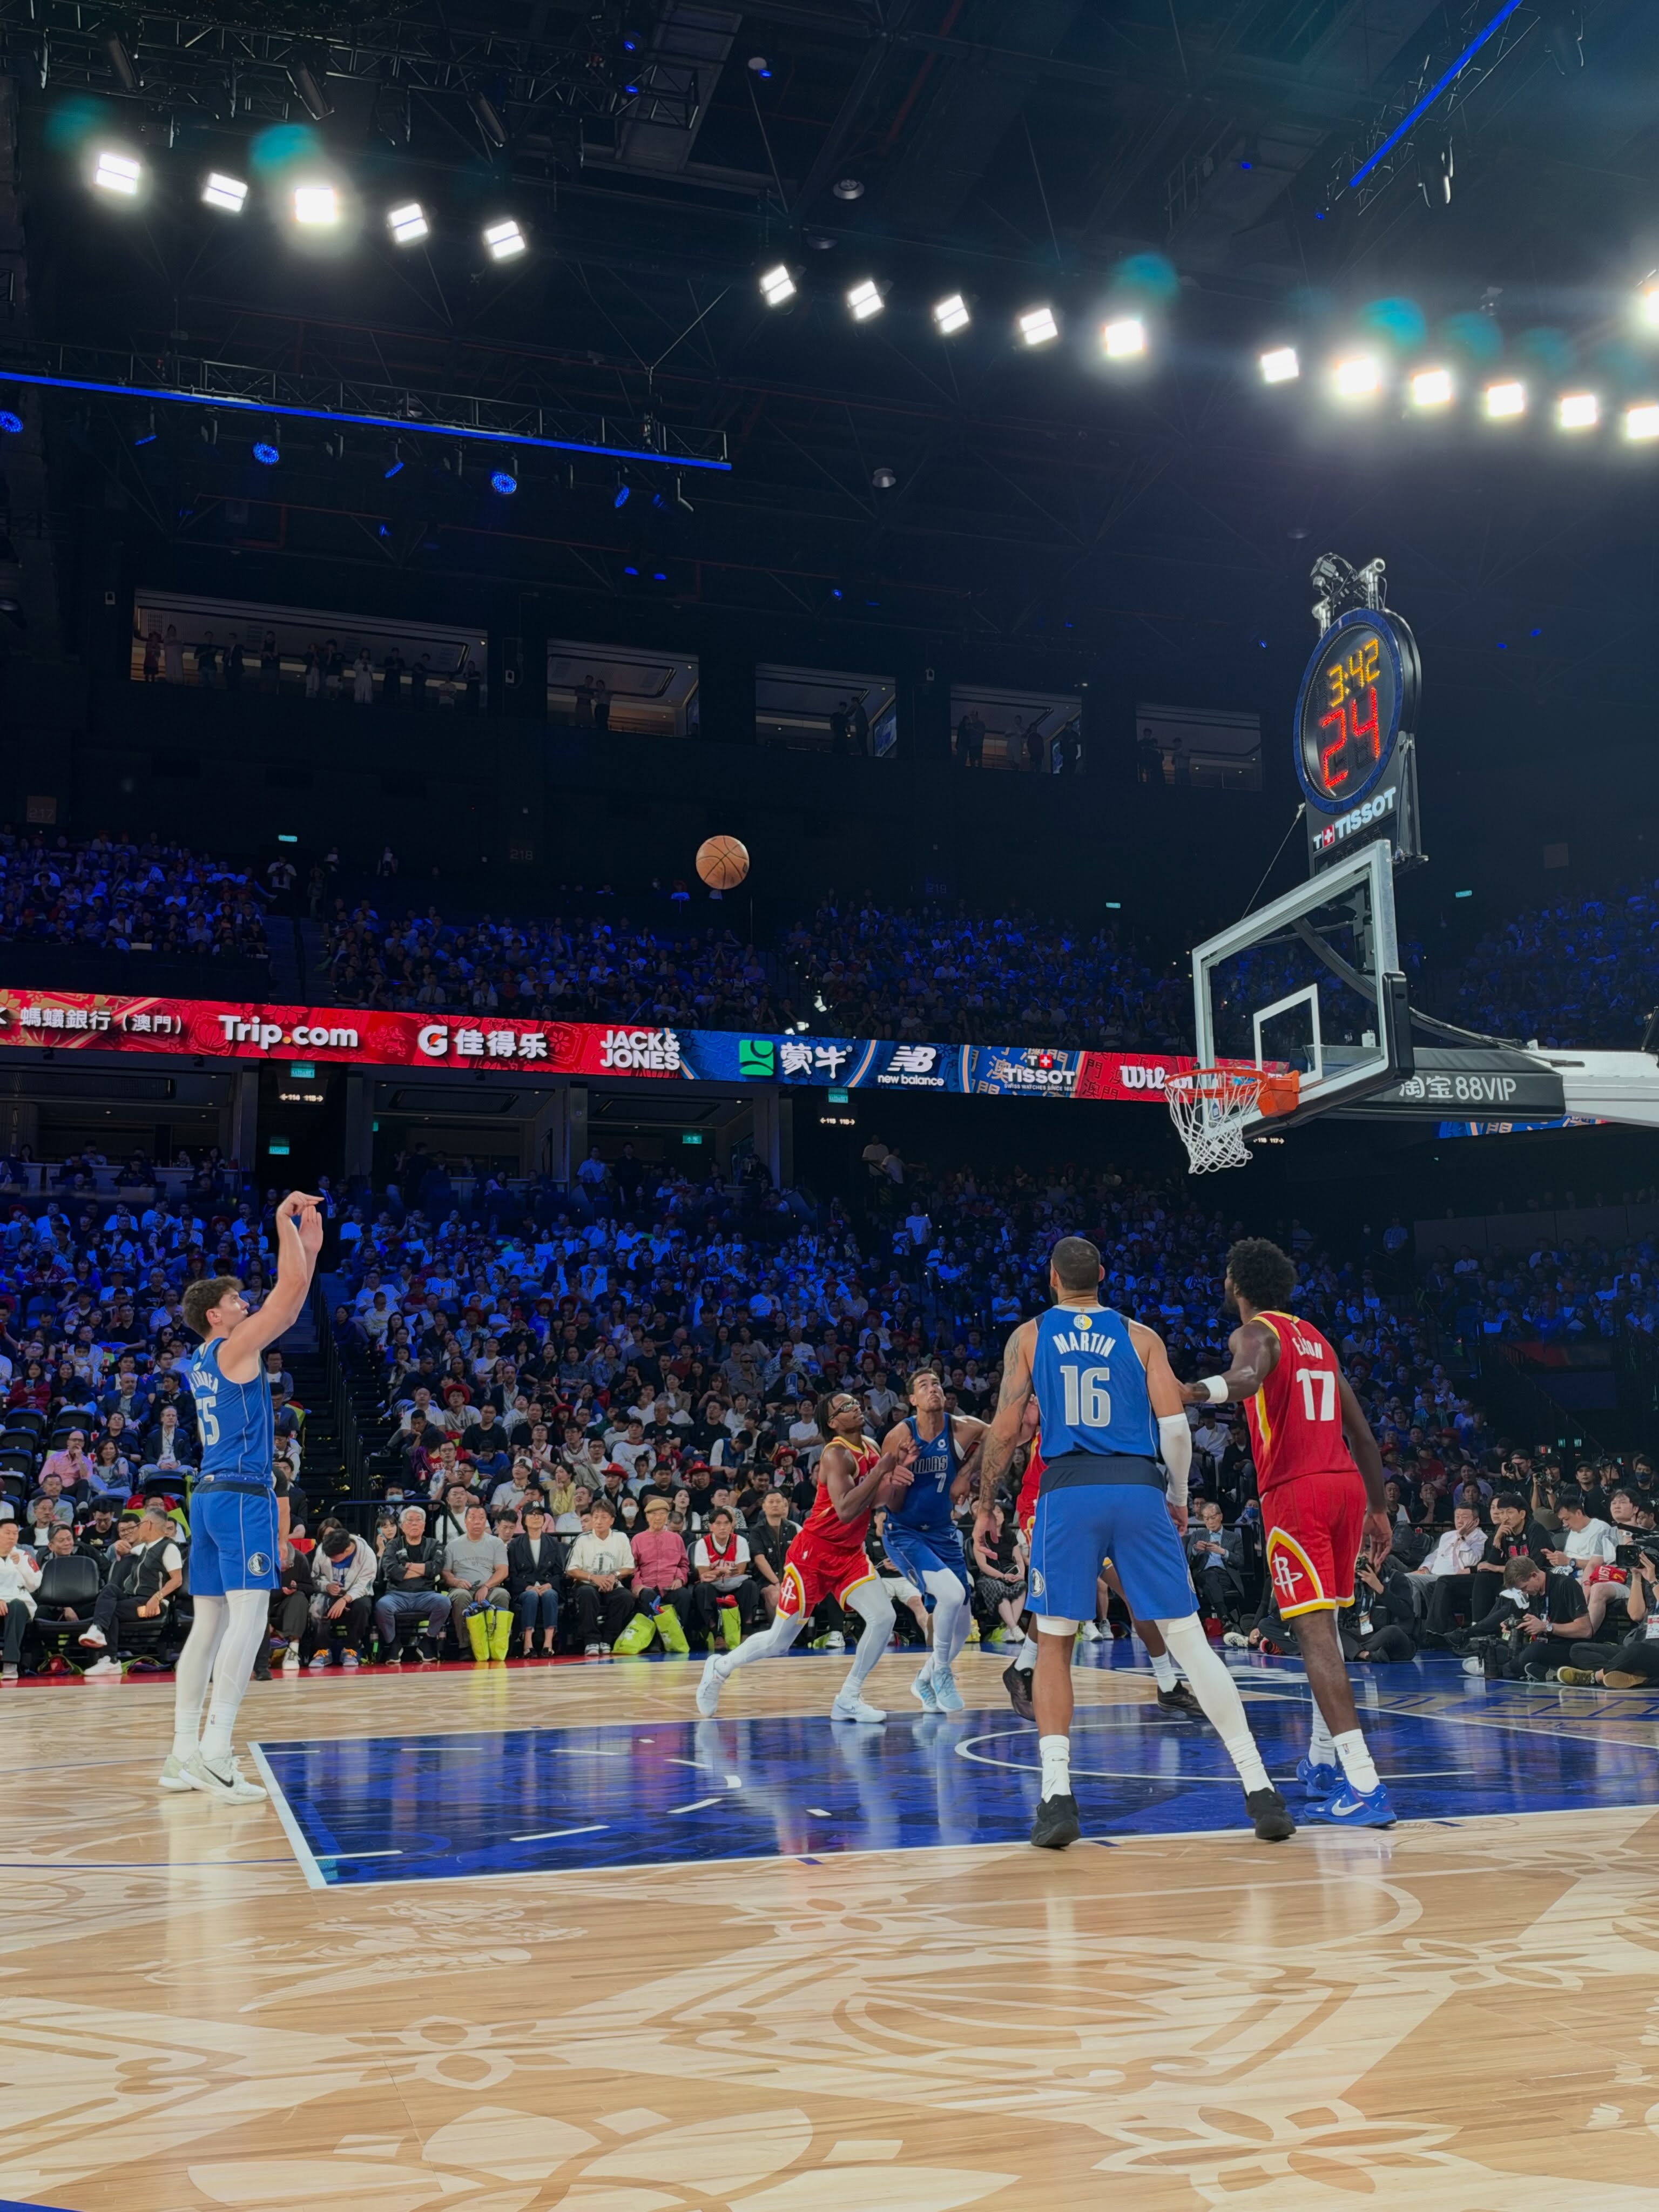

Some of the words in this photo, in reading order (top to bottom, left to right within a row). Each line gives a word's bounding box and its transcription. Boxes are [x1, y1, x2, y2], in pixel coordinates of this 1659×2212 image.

[1327, 638, 1380, 707] 3:42
[1321, 686, 1380, 788] 24
[1335, 786, 1396, 838] TISSOT
[219, 1015, 358, 1049] Trip.com
[455, 1029, 548, 1059] 佳得乐
[600, 1030, 680, 1051] JACK&
[600, 1048, 680, 1070] JONES
[878, 1074, 899, 1084] new
[901, 1075, 945, 1087] balance
[1003, 1068, 1075, 1084] TISSOT
[1053, 1331, 1116, 1358] MARTIN
[1060, 1365, 1111, 1427] 16
[1296, 1368, 1335, 1421] 17
[935, 1472, 947, 1493] 7
